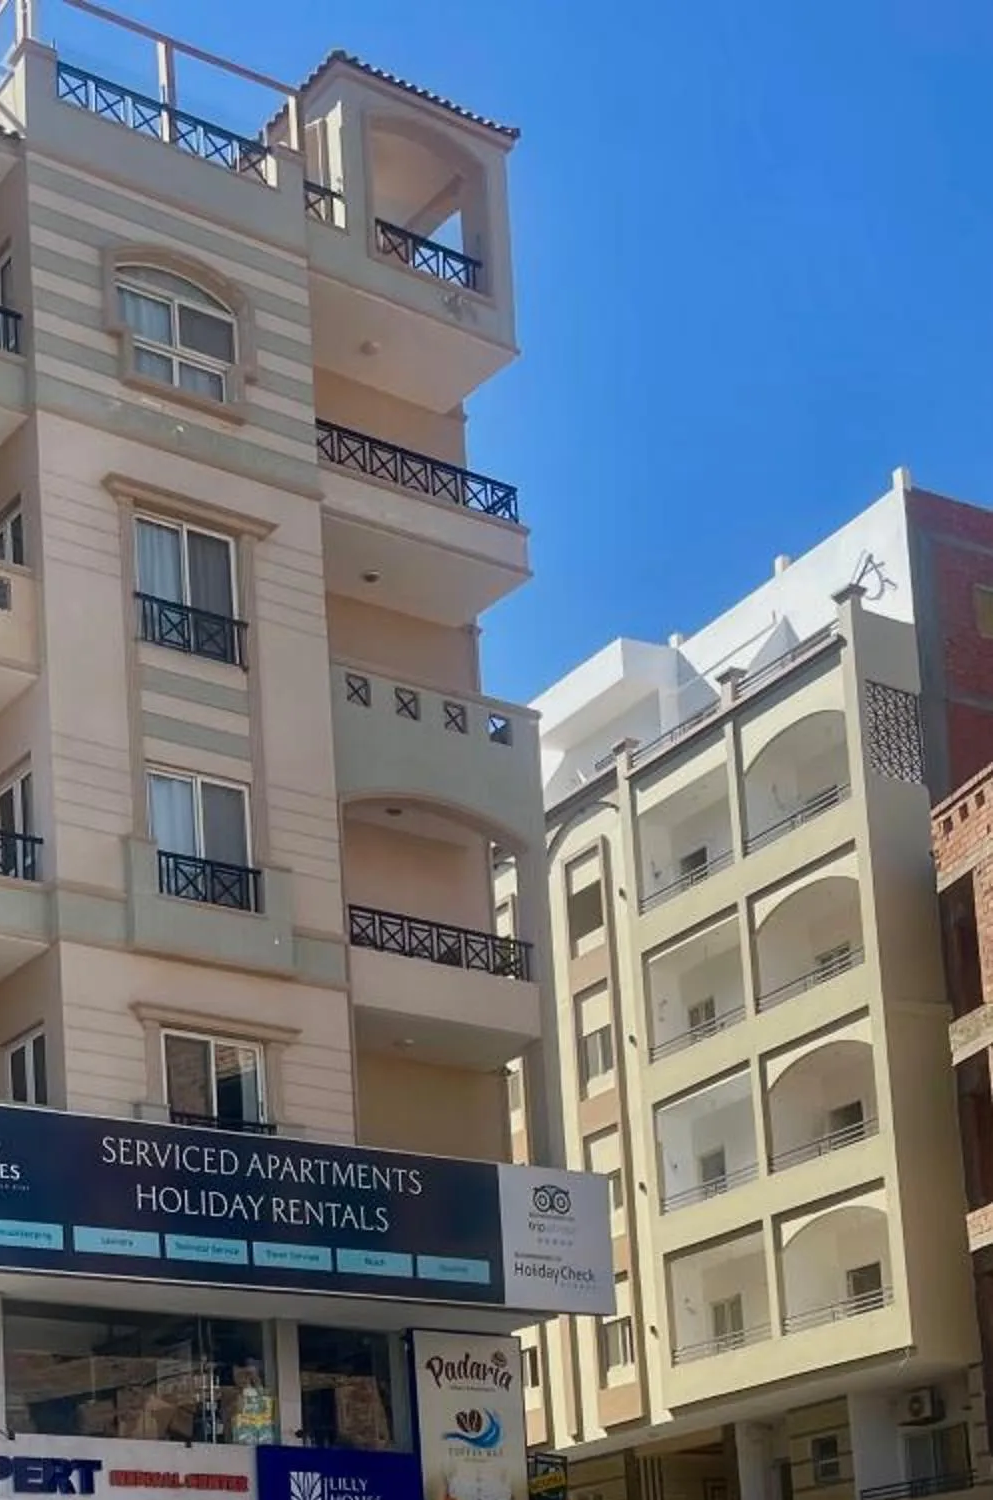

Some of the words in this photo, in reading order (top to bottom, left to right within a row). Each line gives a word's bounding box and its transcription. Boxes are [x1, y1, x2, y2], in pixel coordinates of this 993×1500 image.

[101, 1136, 240, 1176] SERVICED
[246, 1152, 423, 1195] APARTMENTS
[135, 1184, 265, 1221] HOLIDAY
[272, 1198, 390, 1233] RENTALS
[514, 1262, 595, 1285] HolidayCheck
[425, 1350, 514, 1392] Padaria
[329, 1476, 369, 1492] LILLY
